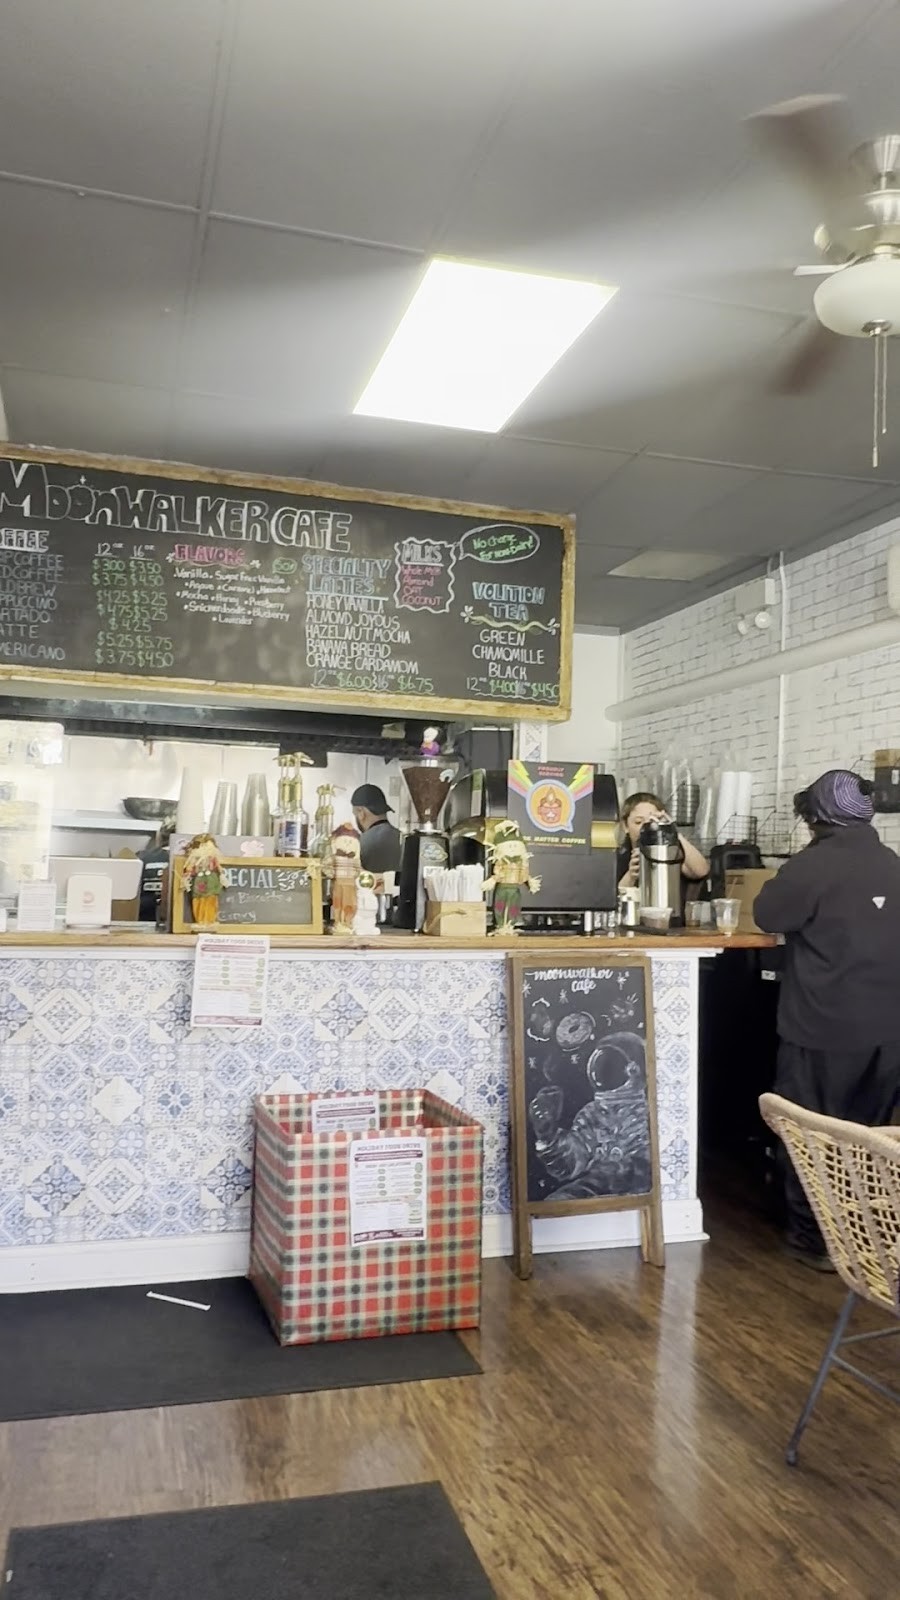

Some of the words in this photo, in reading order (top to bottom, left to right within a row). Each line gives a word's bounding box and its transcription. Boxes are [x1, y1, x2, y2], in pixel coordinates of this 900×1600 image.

[271, 506, 353, 553] CAFE
[97, 543, 111, 555] 12
[133, 545, 144, 557] 16
[174, 543, 245, 563] FLAVORS
[401, 543, 443, 562] MILKS
[176, 567, 209, 579] Vanilla
[302, 553, 391, 578] SPECIALTY
[17, 580, 56, 596] BREW
[309, 573, 375, 595] LATTES
[472, 581, 546, 605] VOLITION
[306, 595, 342, 611] HONEY
[343, 597, 384, 614] VANILLA
[489, 602, 529, 621] TEA
[306, 608, 352, 626] ALMOND
[354, 612, 401, 630] JOYOUS
[373, 628, 411, 644] MOCHA
[479, 628, 526, 646] GREEN
[306, 638, 348, 656] BANANA
[351, 642, 391, 659] BREAD
[472, 644, 545, 664] CHAMOMILLE
[306, 653, 352, 670] ORANGE
[354, 657, 419, 675] CARDAMOM
[488, 662, 527, 681] BLACK
[525, 966, 613, 981] moonwalker
[571, 978, 597, 994] cafe
